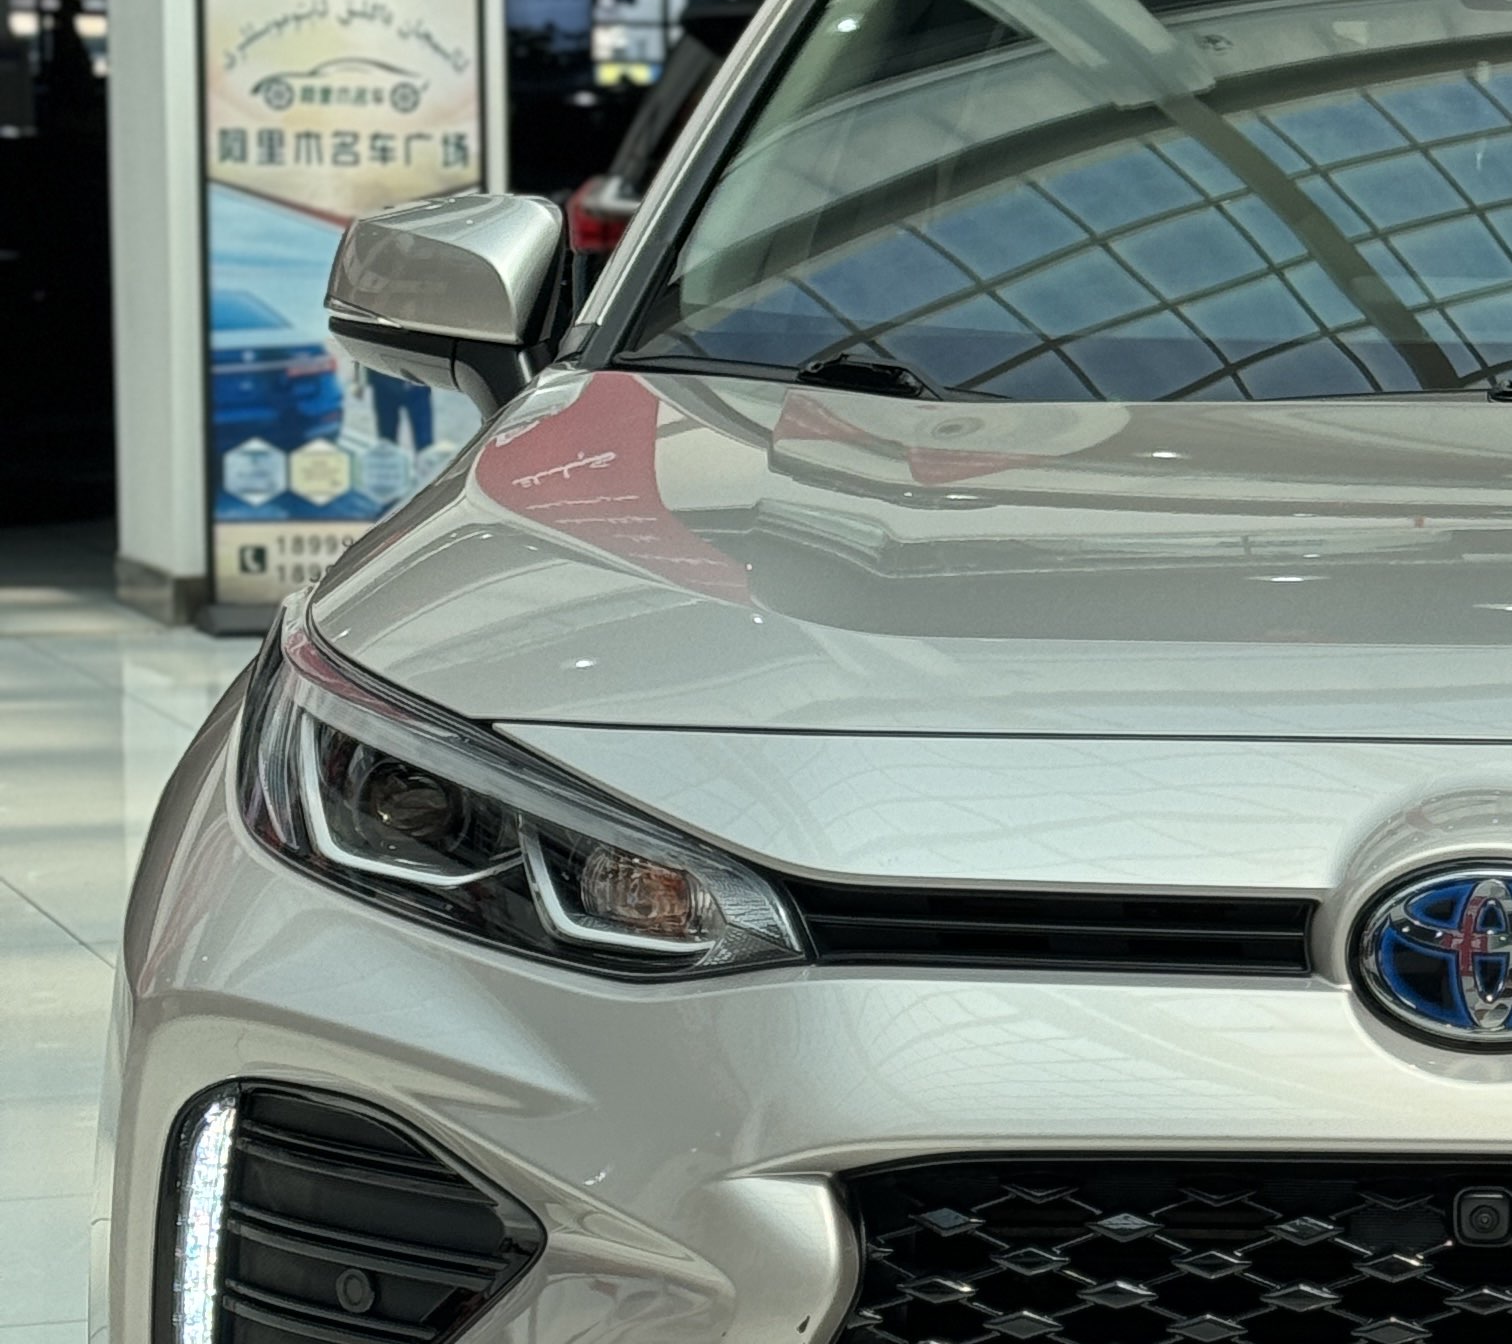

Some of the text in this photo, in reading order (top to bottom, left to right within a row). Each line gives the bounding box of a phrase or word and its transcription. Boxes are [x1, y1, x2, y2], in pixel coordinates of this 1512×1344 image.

[217, 128, 469, 169] 阿里木名车广场
